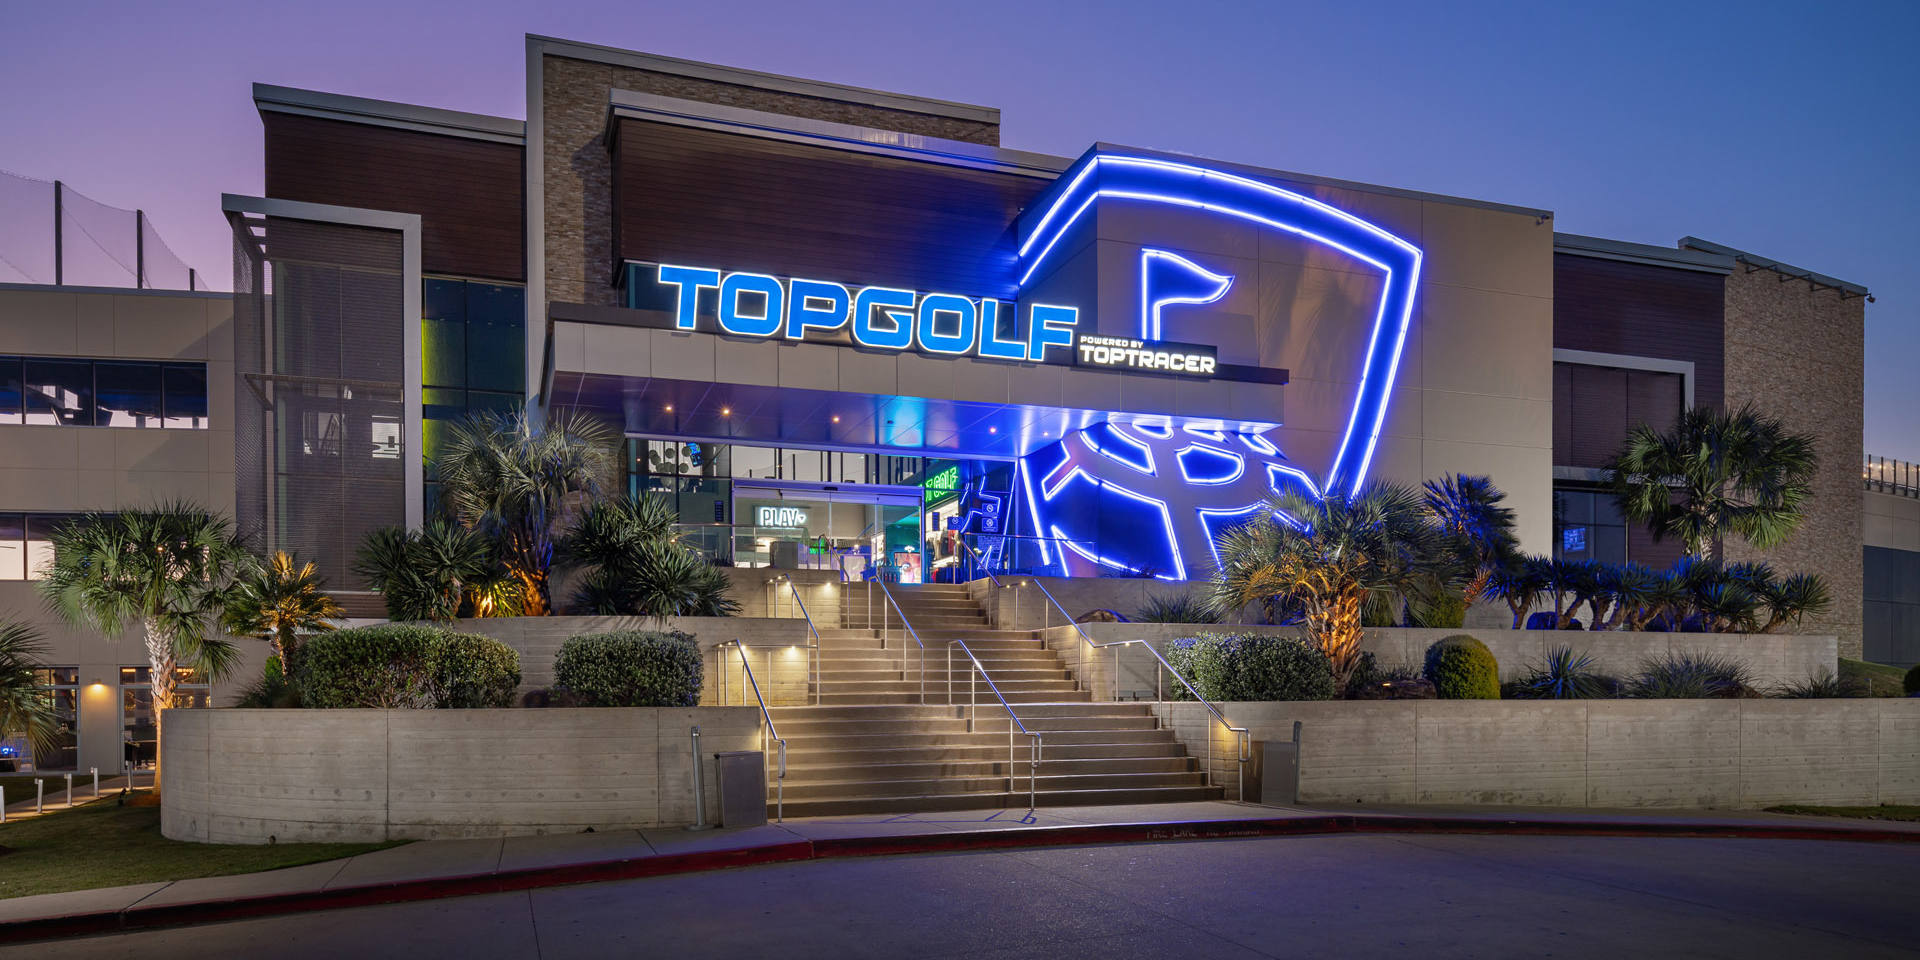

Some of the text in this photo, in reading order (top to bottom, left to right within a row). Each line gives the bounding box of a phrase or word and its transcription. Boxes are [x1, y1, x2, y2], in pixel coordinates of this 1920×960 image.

[658, 264, 1078, 362] TOPGOLF
[1080, 335, 1144, 349] POWERED BY
[1079, 345, 1216, 374] TOPTRACER
[933, 466, 957, 498] GOLF
[760, 507, 798, 528] PLAY
